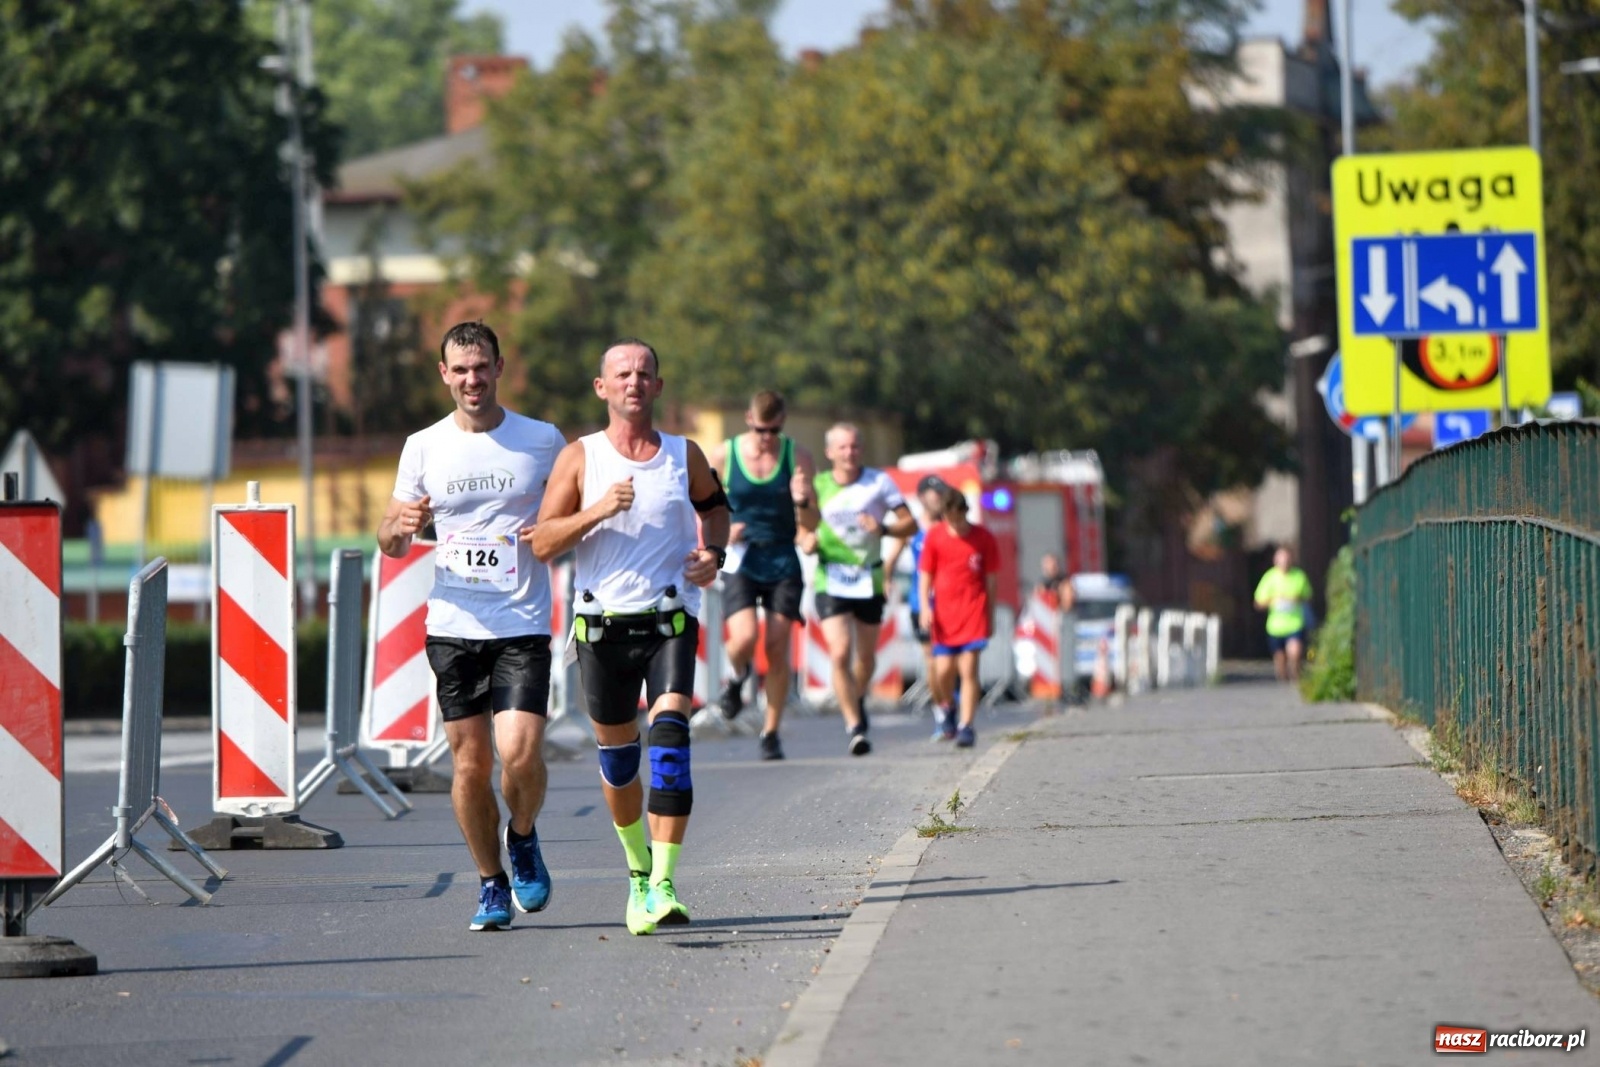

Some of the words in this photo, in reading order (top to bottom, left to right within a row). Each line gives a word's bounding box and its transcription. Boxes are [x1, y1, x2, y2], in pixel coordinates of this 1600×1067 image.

[1357, 168, 1516, 212] Uwaga
[446, 474, 516, 495] eventyr
[465, 549, 499, 567] 126
